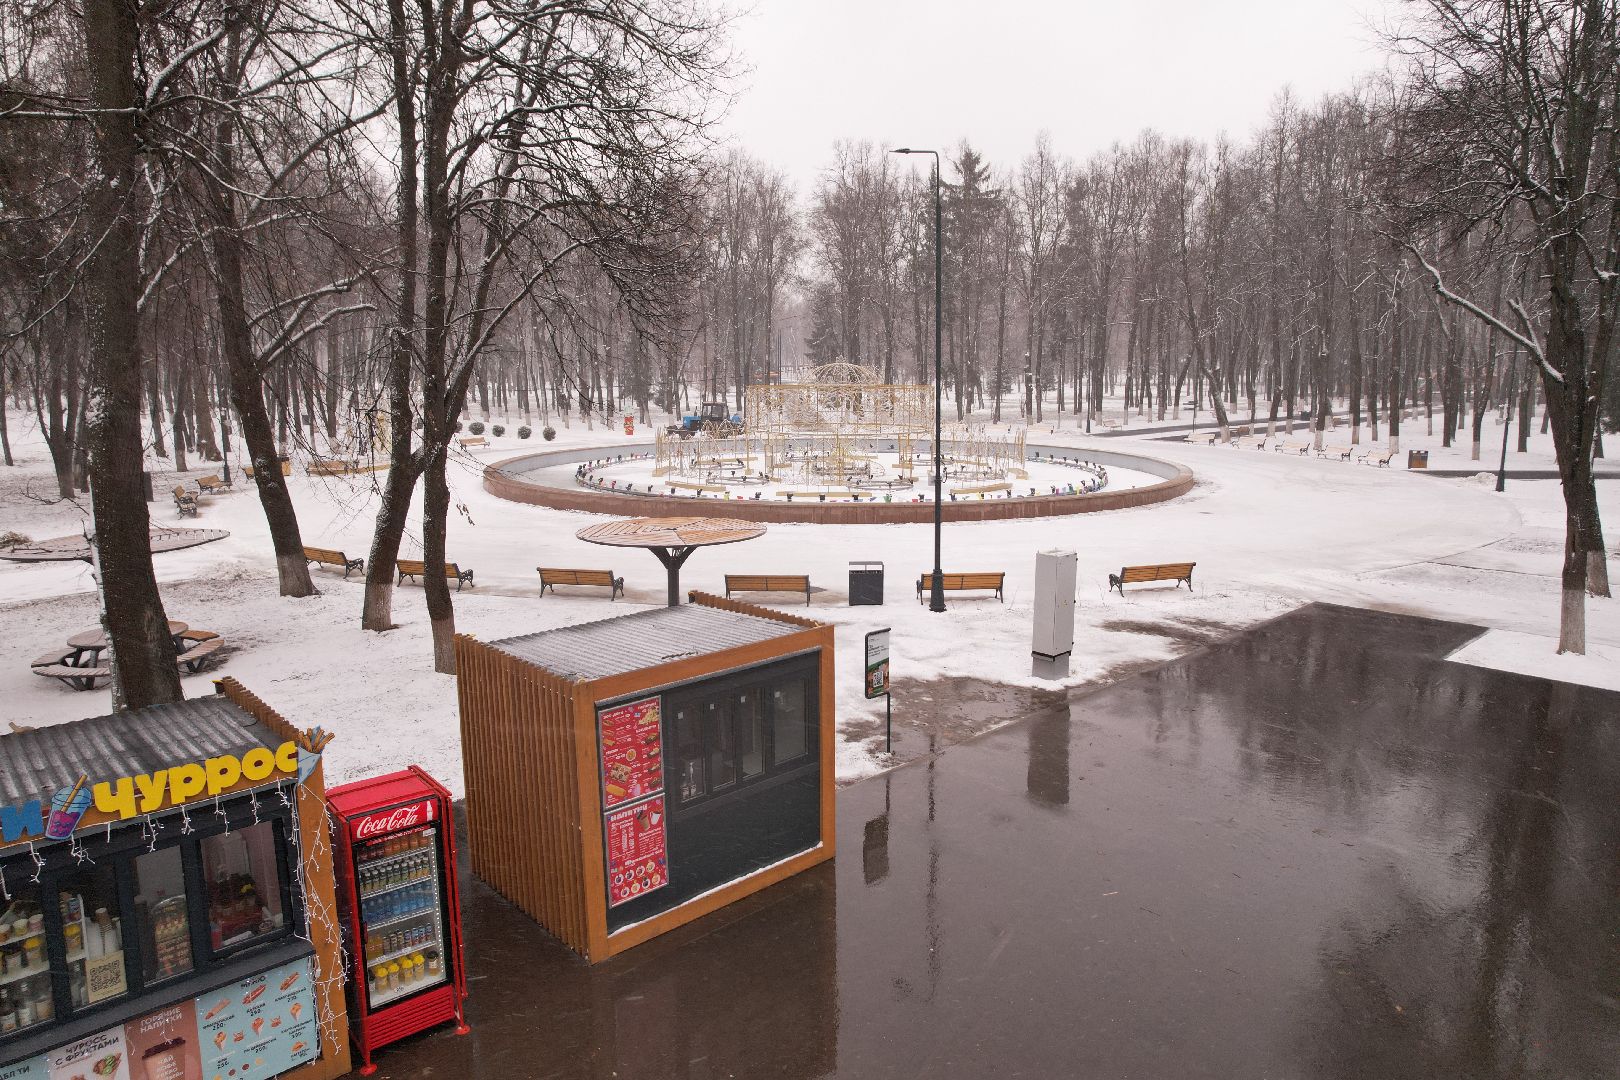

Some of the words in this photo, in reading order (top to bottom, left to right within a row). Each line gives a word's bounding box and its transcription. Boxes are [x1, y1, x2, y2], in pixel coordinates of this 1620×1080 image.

[141, 1006, 181, 1027] ГОРЯЧИЕ
[55, 1057, 63, 1066] С
[65, 1036, 119, 1062] ФРУКТАМИ
[65, 1034, 108, 1054] ЧУРОСС
